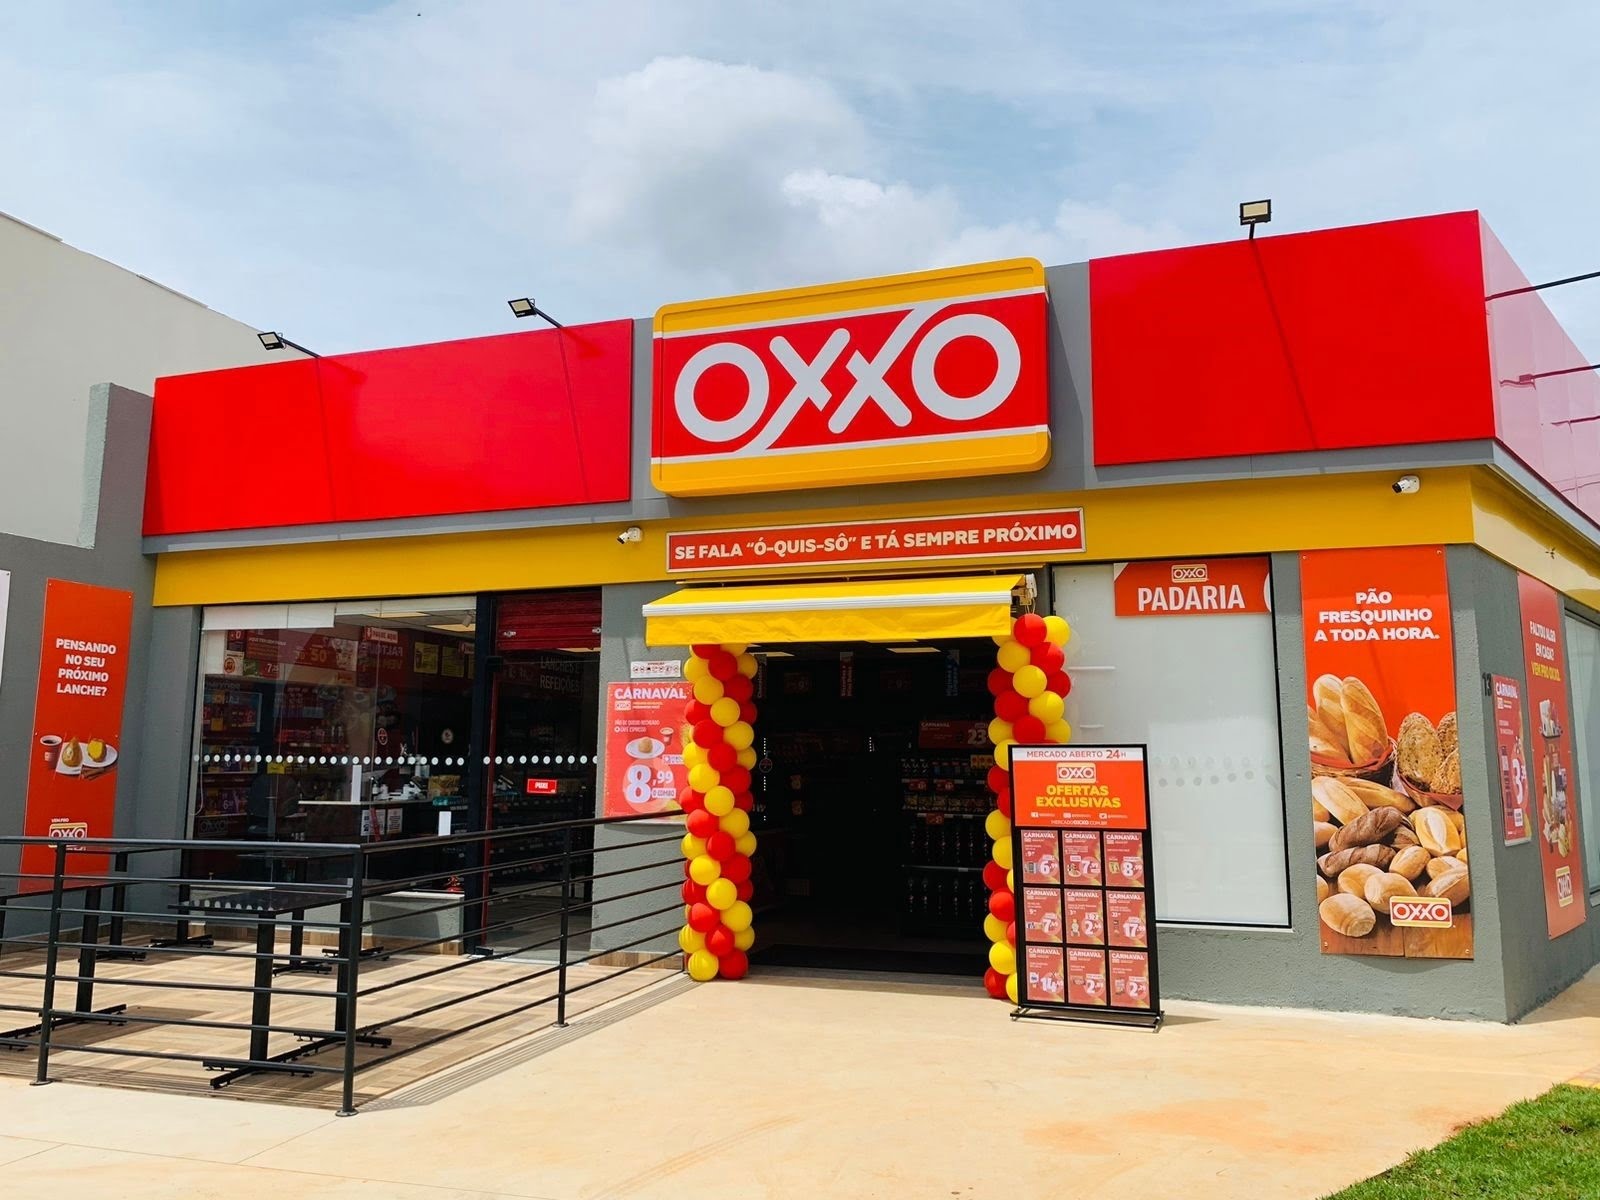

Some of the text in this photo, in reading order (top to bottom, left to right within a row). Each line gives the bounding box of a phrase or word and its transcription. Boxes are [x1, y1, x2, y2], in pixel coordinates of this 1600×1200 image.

[674, 300, 1021, 456] OXXO
[675, 546, 695, 560] SE
[698, 542, 743, 559] FALA
[861, 536, 871, 550] E
[874, 528, 900, 550] TÁ
[904, 529, 979, 549] SEMPRE
[983, 521, 1078, 543] PRÓXIMO
[1173, 567, 1206, 580] OXXO
[1137, 584, 1246, 612] PADARIA
[1355, 587, 1393, 605] PÃO
[1318, 608, 1433, 626] FRESQUINHO
[1313, 626, 1441, 642] A TODA HORA.
[1530, 621, 1546, 639] FALTOU
[55, 637, 117, 655] PENSANDO
[65, 654, 106, 667] NO SEU
[58, 666, 109, 682] PRÓXIMO
[56, 682, 108, 697] LANCHE?
[1482, 672, 1492, 696] 13
[1495, 682, 1518, 699] CARNAVAL
[614, 687, 688, 700] CARNAVAL
[1026, 750, 1067, 758] MERCADO
[1069, 750, 1103, 758] ABERTO
[1058, 767, 1094, 780] OXXO
[1046, 785, 1109, 796] OFERTAS
[1035, 797, 1121, 808] EXCLUSIVAS
[51, 828, 86, 839] OXXO
[1026, 889, 1058, 897] CARNAVAL
[1108, 893, 1142, 901] CARNAVAL
[1393, 903, 1449, 921] OXXO
[1028, 948, 1060, 956] CARNAVAL
[1069, 950, 1102, 958] CARNAVAL
[1111, 952, 1145, 961] CARNAVAL
